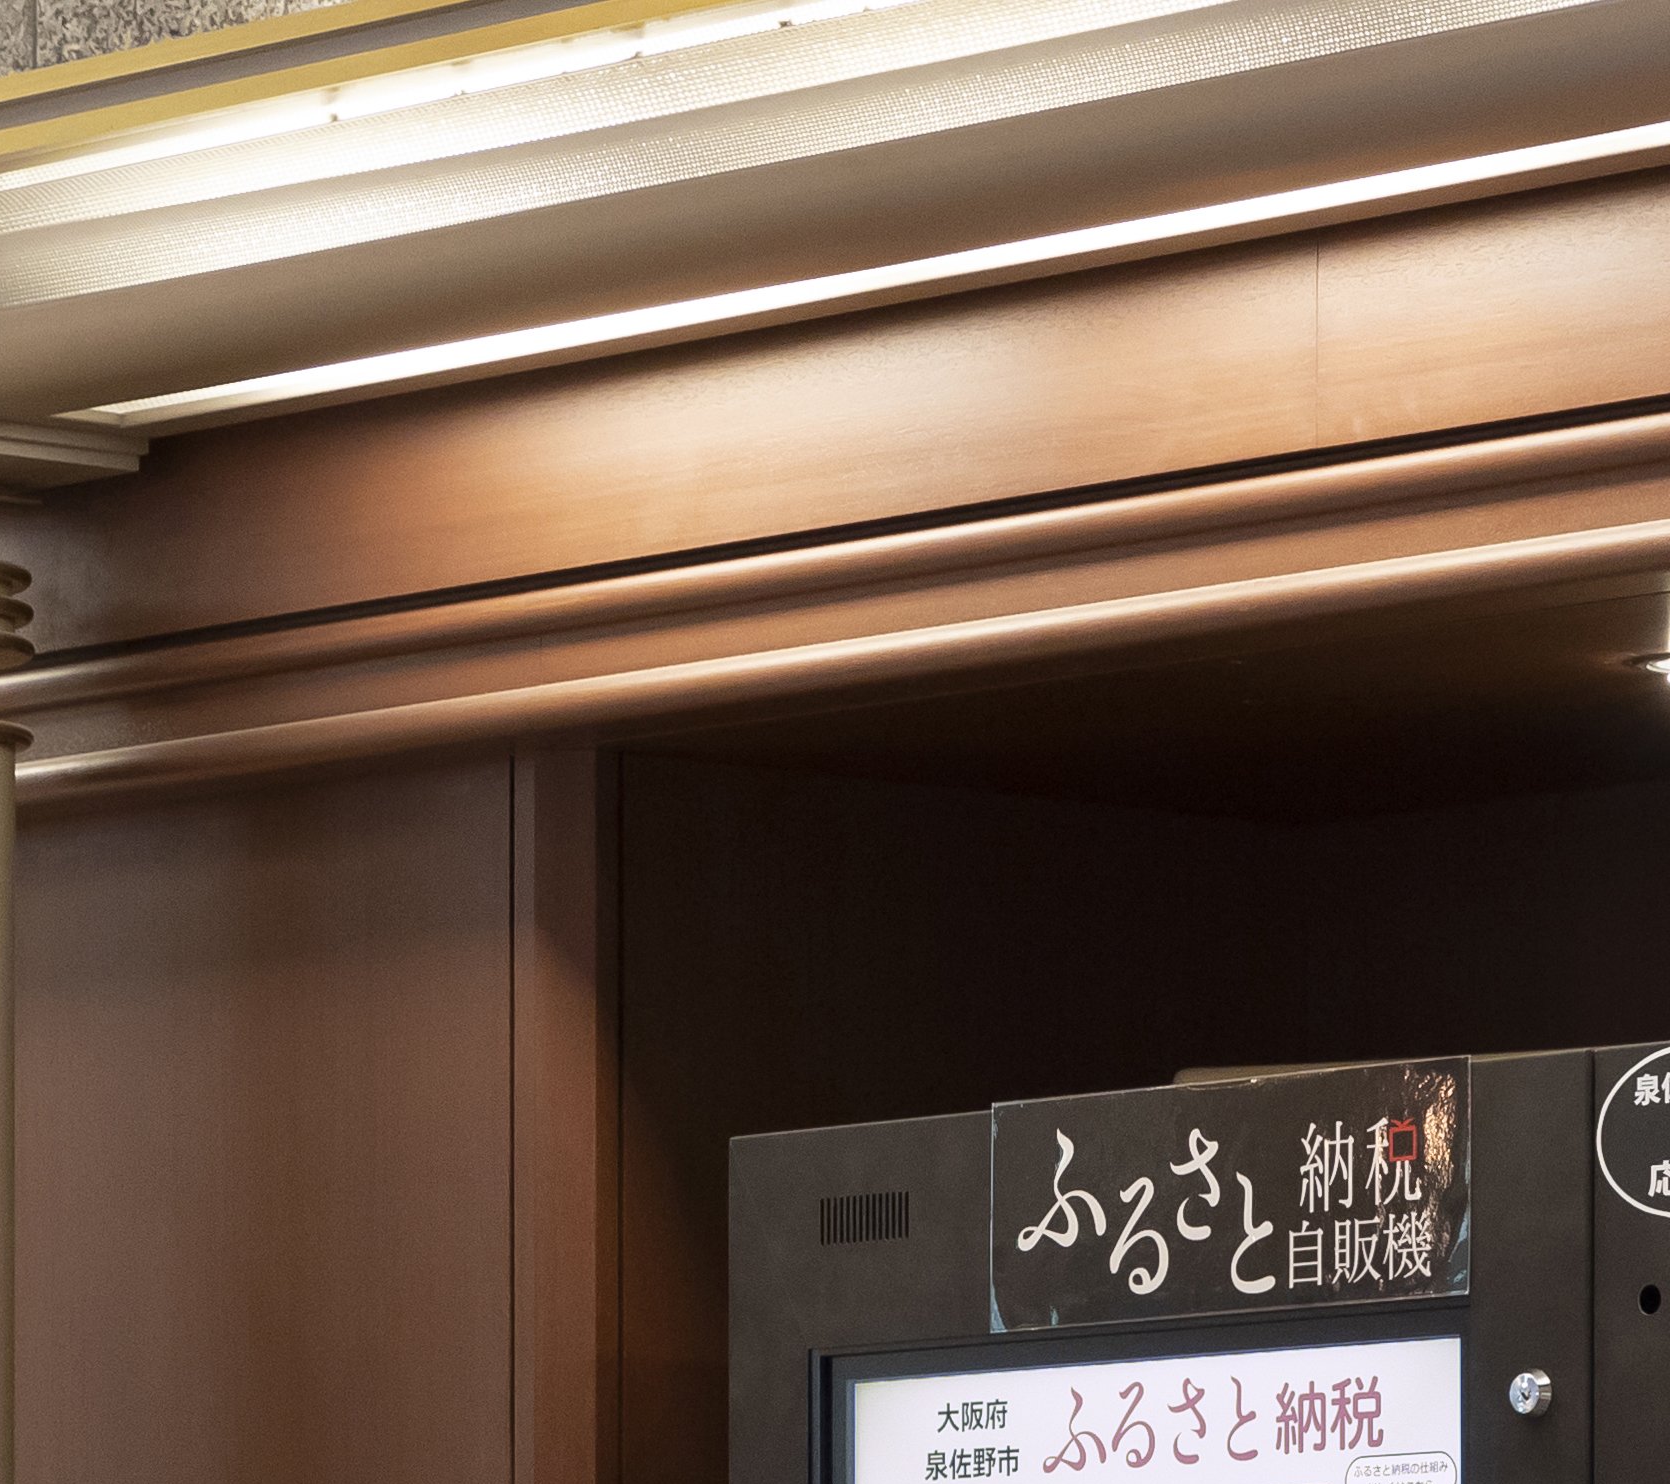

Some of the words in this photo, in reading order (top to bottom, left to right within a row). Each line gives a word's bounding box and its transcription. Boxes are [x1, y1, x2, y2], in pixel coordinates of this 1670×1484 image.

[1300, 1117, 1422, 1212] 納税
[1018, 1127, 1275, 1294] ふるさと
[1288, 1212, 1432, 1289] 自販機
[937, 1399, 1008, 1433] 大阪府
[1042, 1375, 1385, 1474] ふるさと納税
[924, 1445, 1020, 1481] 泉佐野市
[1354, 1461, 1448, 1477] ふるさと納税の仕組み
